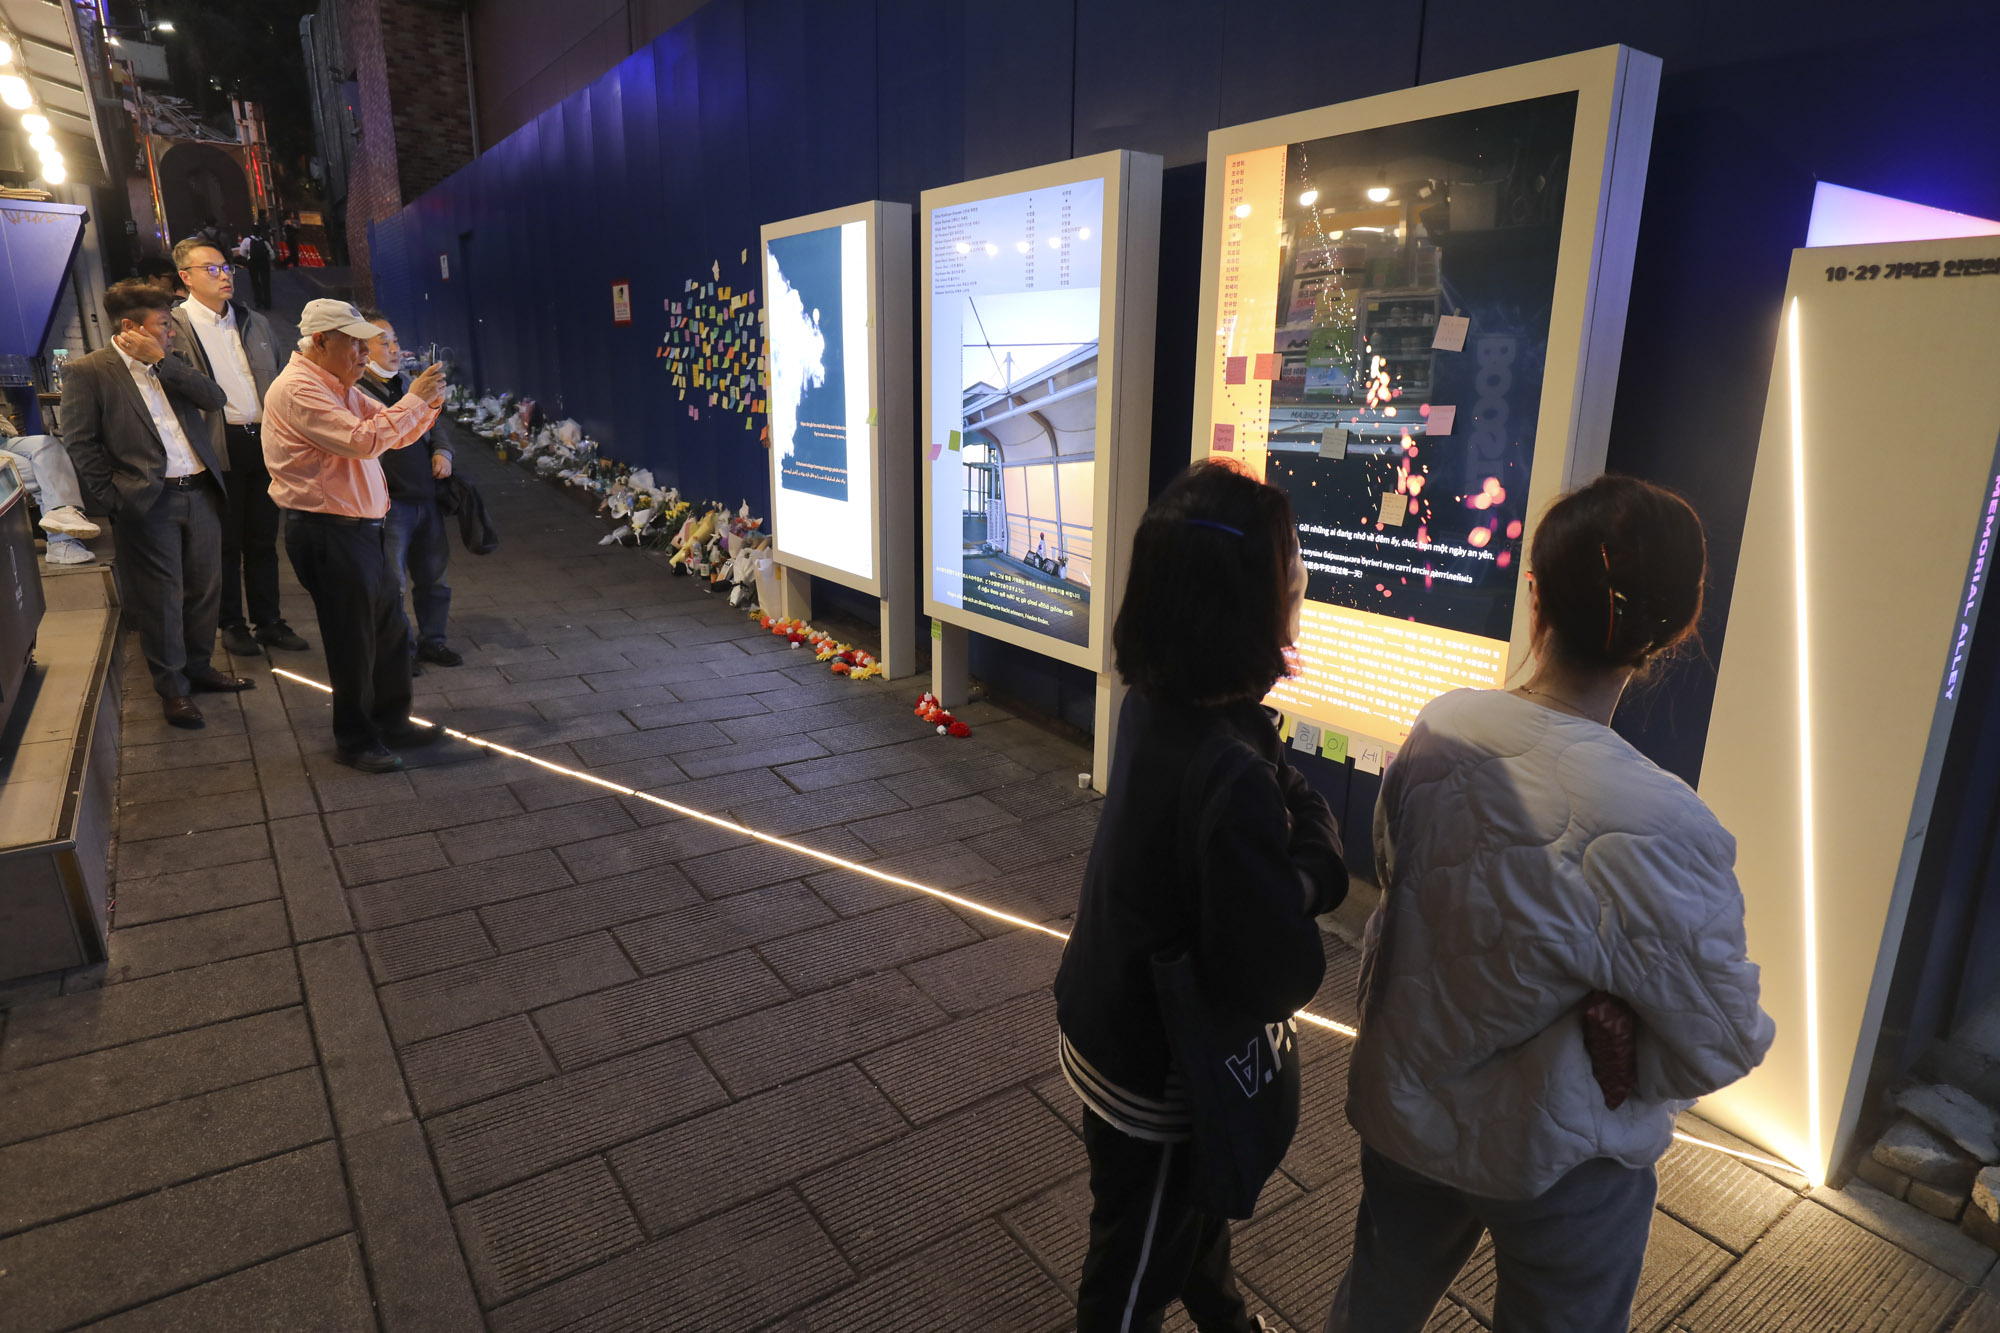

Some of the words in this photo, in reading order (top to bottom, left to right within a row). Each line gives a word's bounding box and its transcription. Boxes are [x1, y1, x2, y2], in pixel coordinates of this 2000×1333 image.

[1884, 260, 1941, 279] 기억과
[1330, 528, 1336, 536] ai
[1401, 538, 1418, 549] chúc
[1418, 541, 1432, 551] bạn
[1449, 546, 1467, 558] ngày
[1467, 550, 1477, 558] an
[1964, 475, 2000, 617] MEMORIAL
[1945, 623, 1969, 700] ALLEY
